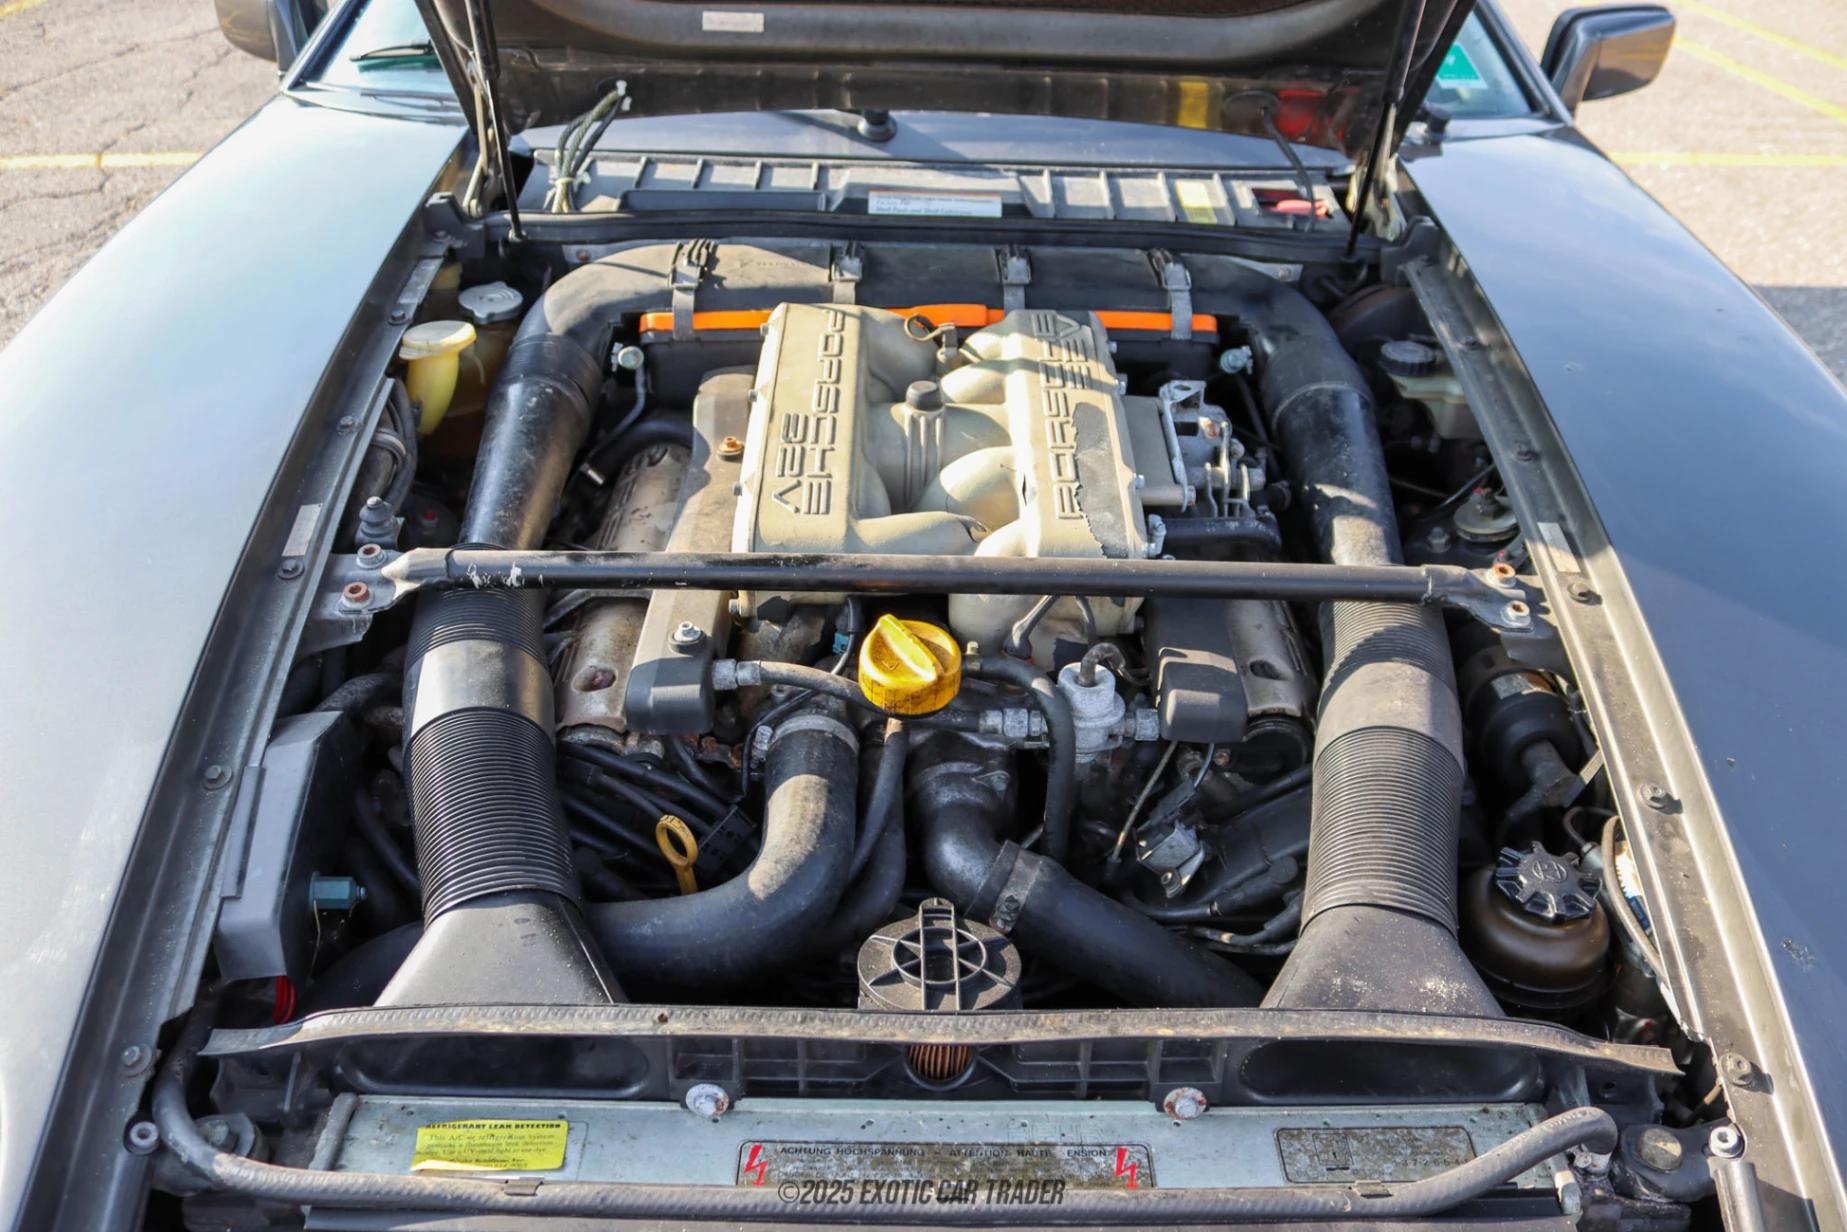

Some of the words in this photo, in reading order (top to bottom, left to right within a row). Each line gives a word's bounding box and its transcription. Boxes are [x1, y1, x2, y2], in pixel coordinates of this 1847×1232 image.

[1055, 313, 1092, 390] 32V
[801, 309, 845, 515] PORSCHE
[1031, 312, 1084, 520] PORSCHE
[772, 412, 808, 514] 32V
[529, 1134, 555, 1142] system
[836, 1147, 925, 1156] HOCHSPANNUNG
